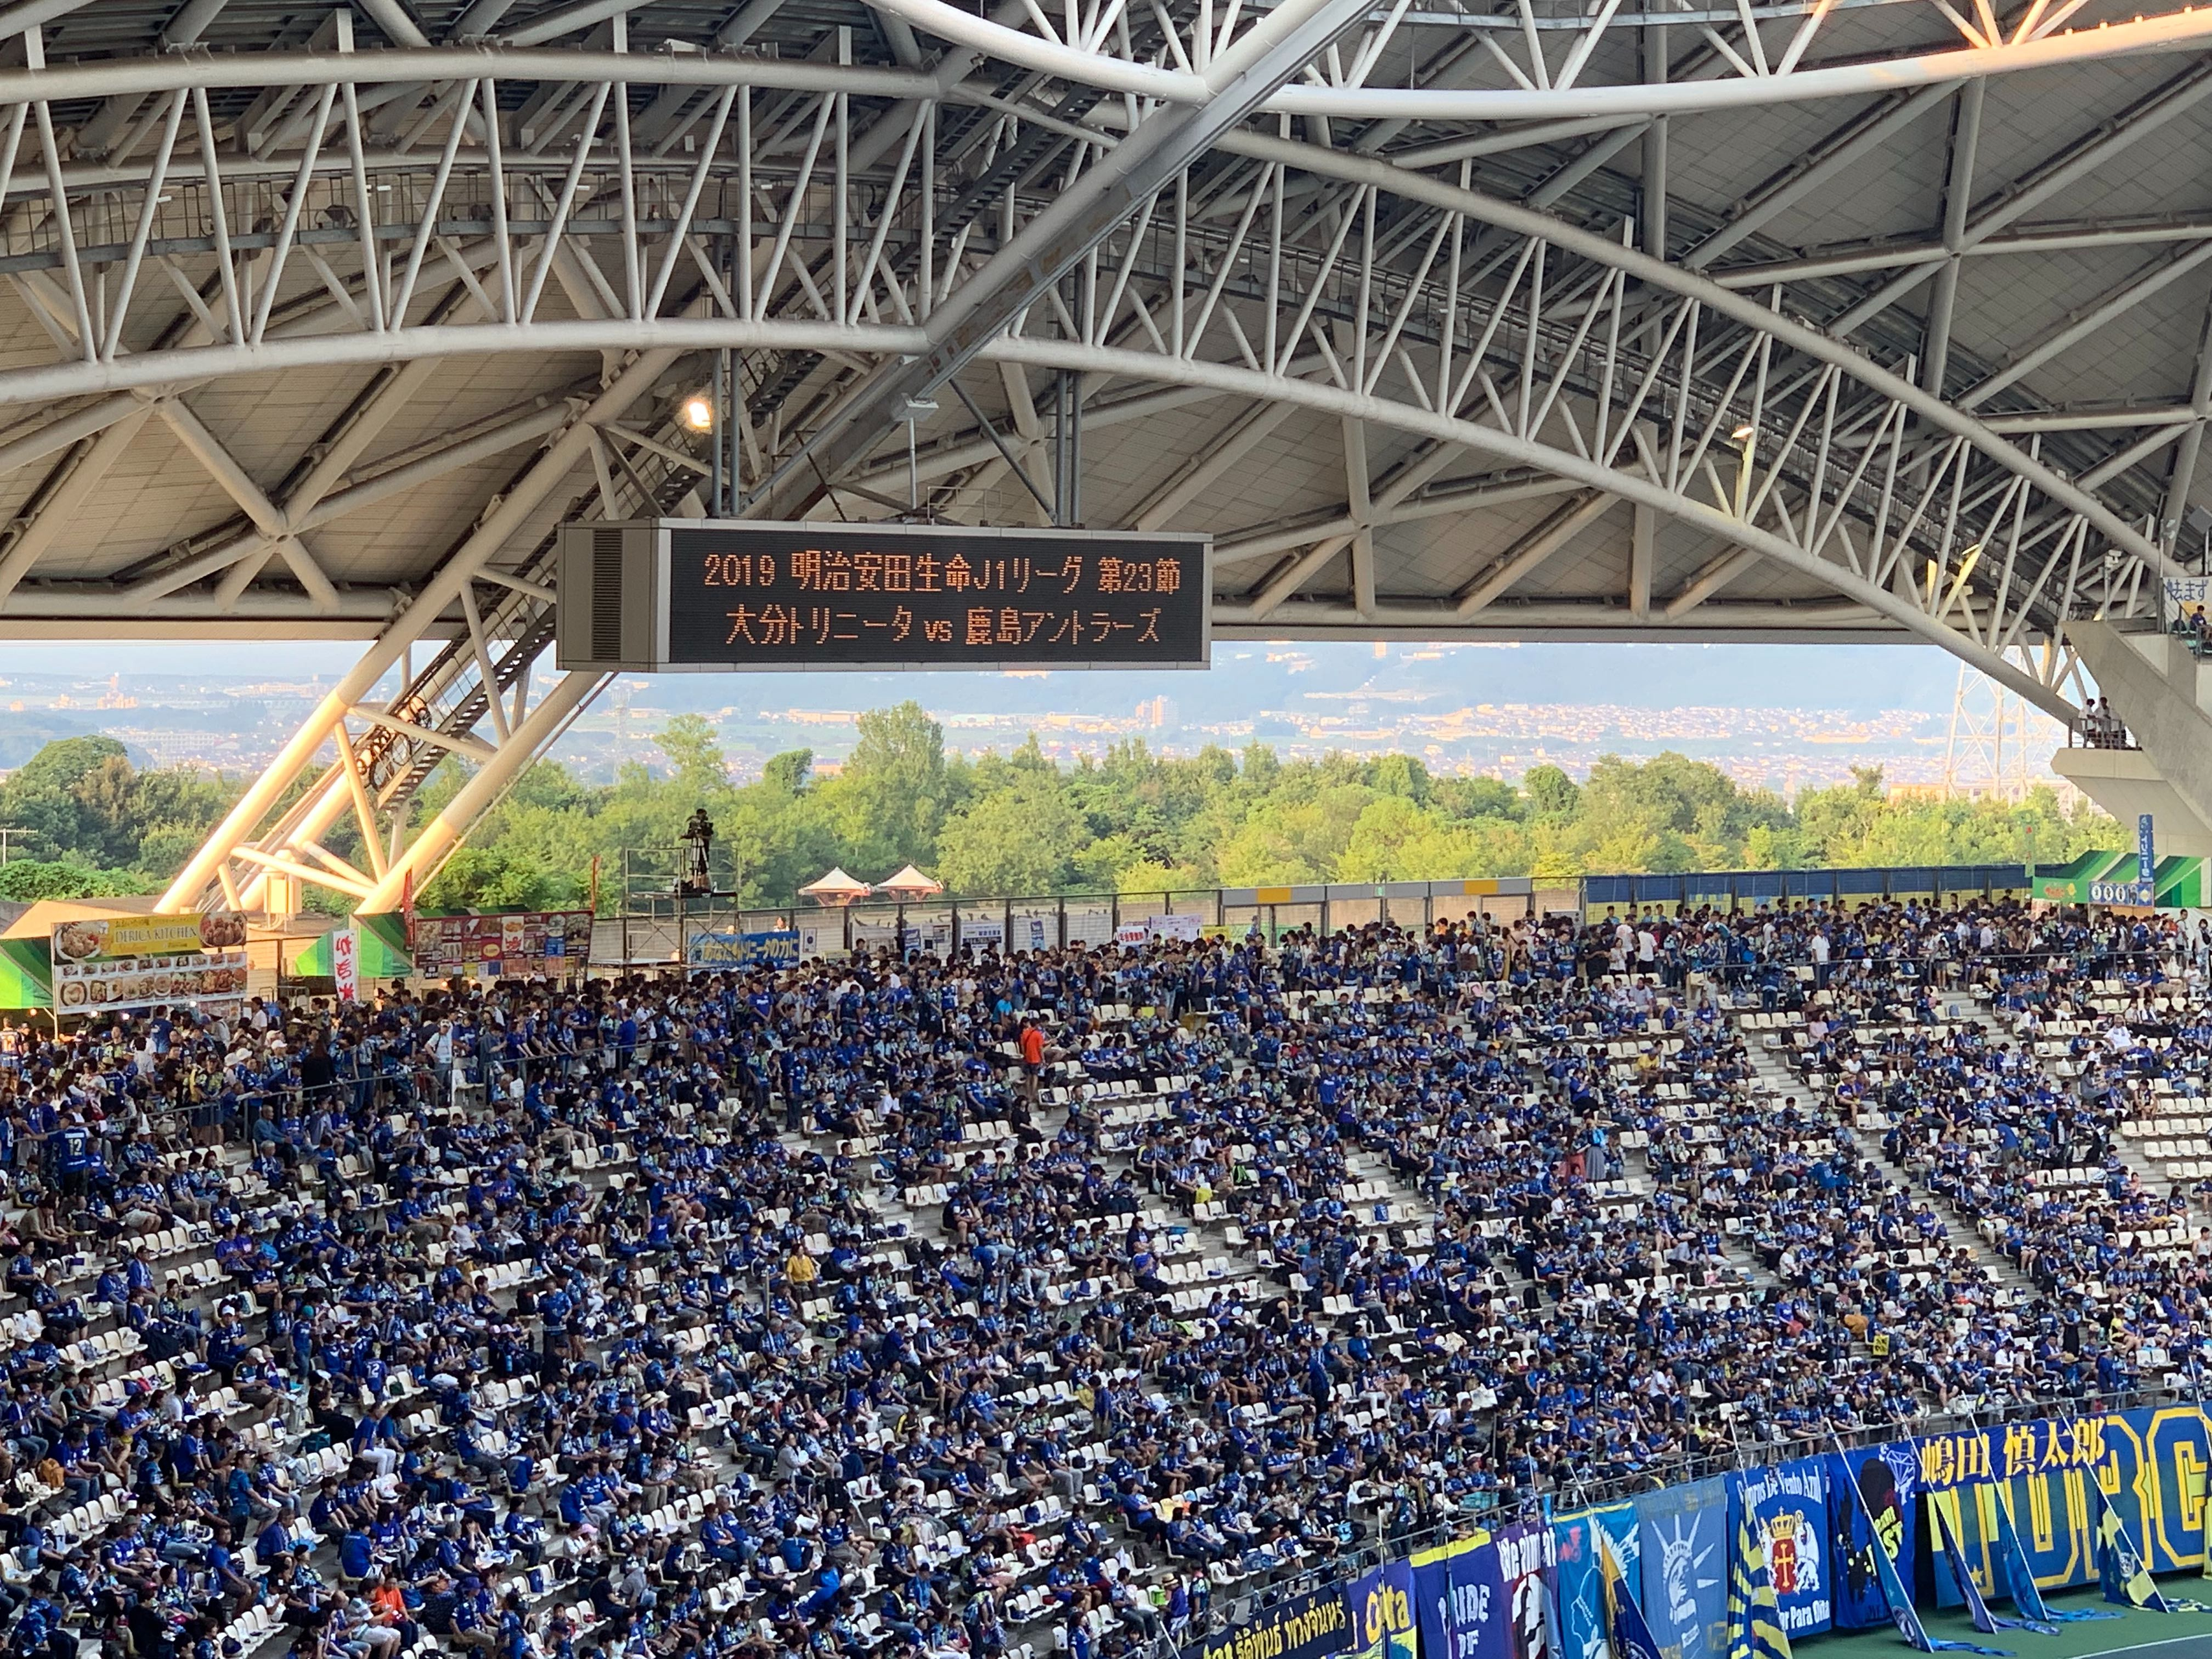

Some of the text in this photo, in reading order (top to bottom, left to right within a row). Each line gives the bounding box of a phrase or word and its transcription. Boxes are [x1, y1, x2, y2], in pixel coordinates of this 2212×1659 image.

[704, 550, 1181, 595] 2019 明治安田生命J1リーグ 第23節
[726, 603, 1162, 645] 大分トリニータ vs 鹿島アントラーズ
[153, 925, 197, 940] KITCHEN
[68, 1138, 82, 1156] 12
[366, 1363, 380, 1378] 12
[1920, 1416, 2106, 1487] 嶋田 慎太郎
[1496, 1537, 1520, 1583] We
[1519, 1527, 1541, 1576] aim
[1790, 1606, 1813, 1630] Para
[1812, 1599, 1830, 1624] Oita
